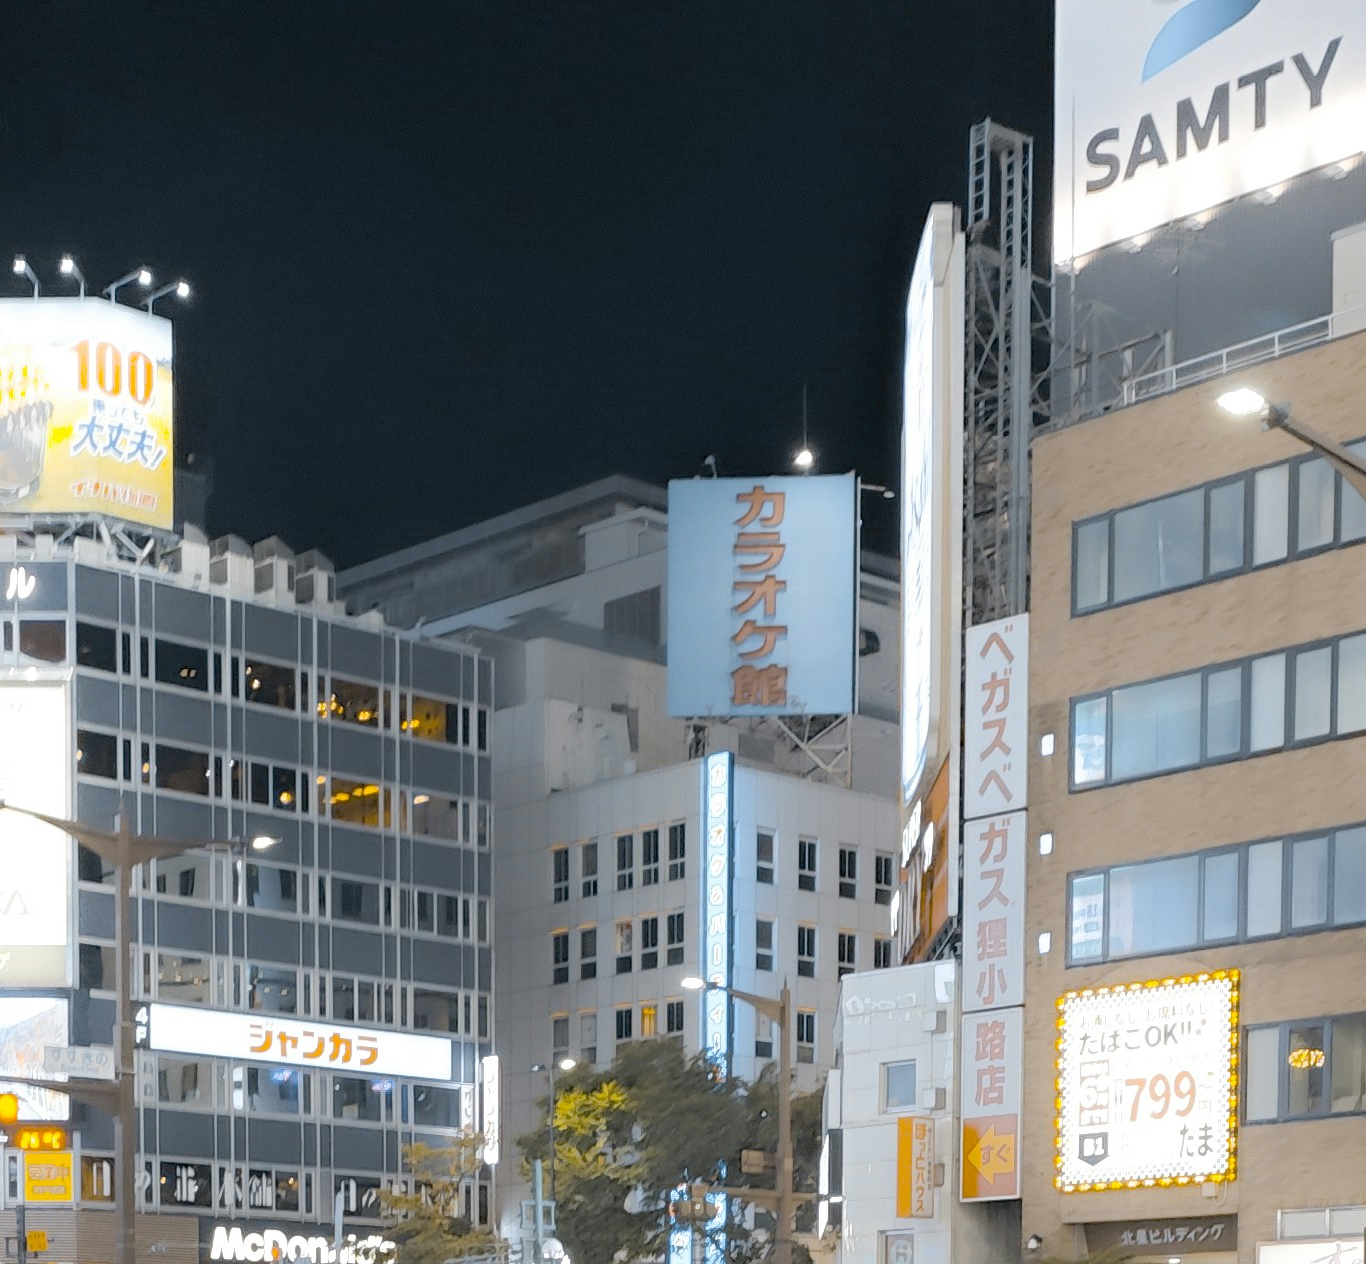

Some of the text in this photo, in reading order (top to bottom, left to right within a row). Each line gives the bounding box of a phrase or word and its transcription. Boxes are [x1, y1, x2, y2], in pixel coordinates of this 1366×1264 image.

[1086, 35, 1344, 195] SAMTY
[731, 486, 787, 706] カラオケ館
[974, 624, 1014, 1106] ベガスベガス狸小路店
[249, 1022, 379, 1066] ジャンカラ
[1125, 1070, 1197, 1122] 799
[980, 1143, 1011, 1166] すぐ
[1180, 1123, 1214, 1158] たま
